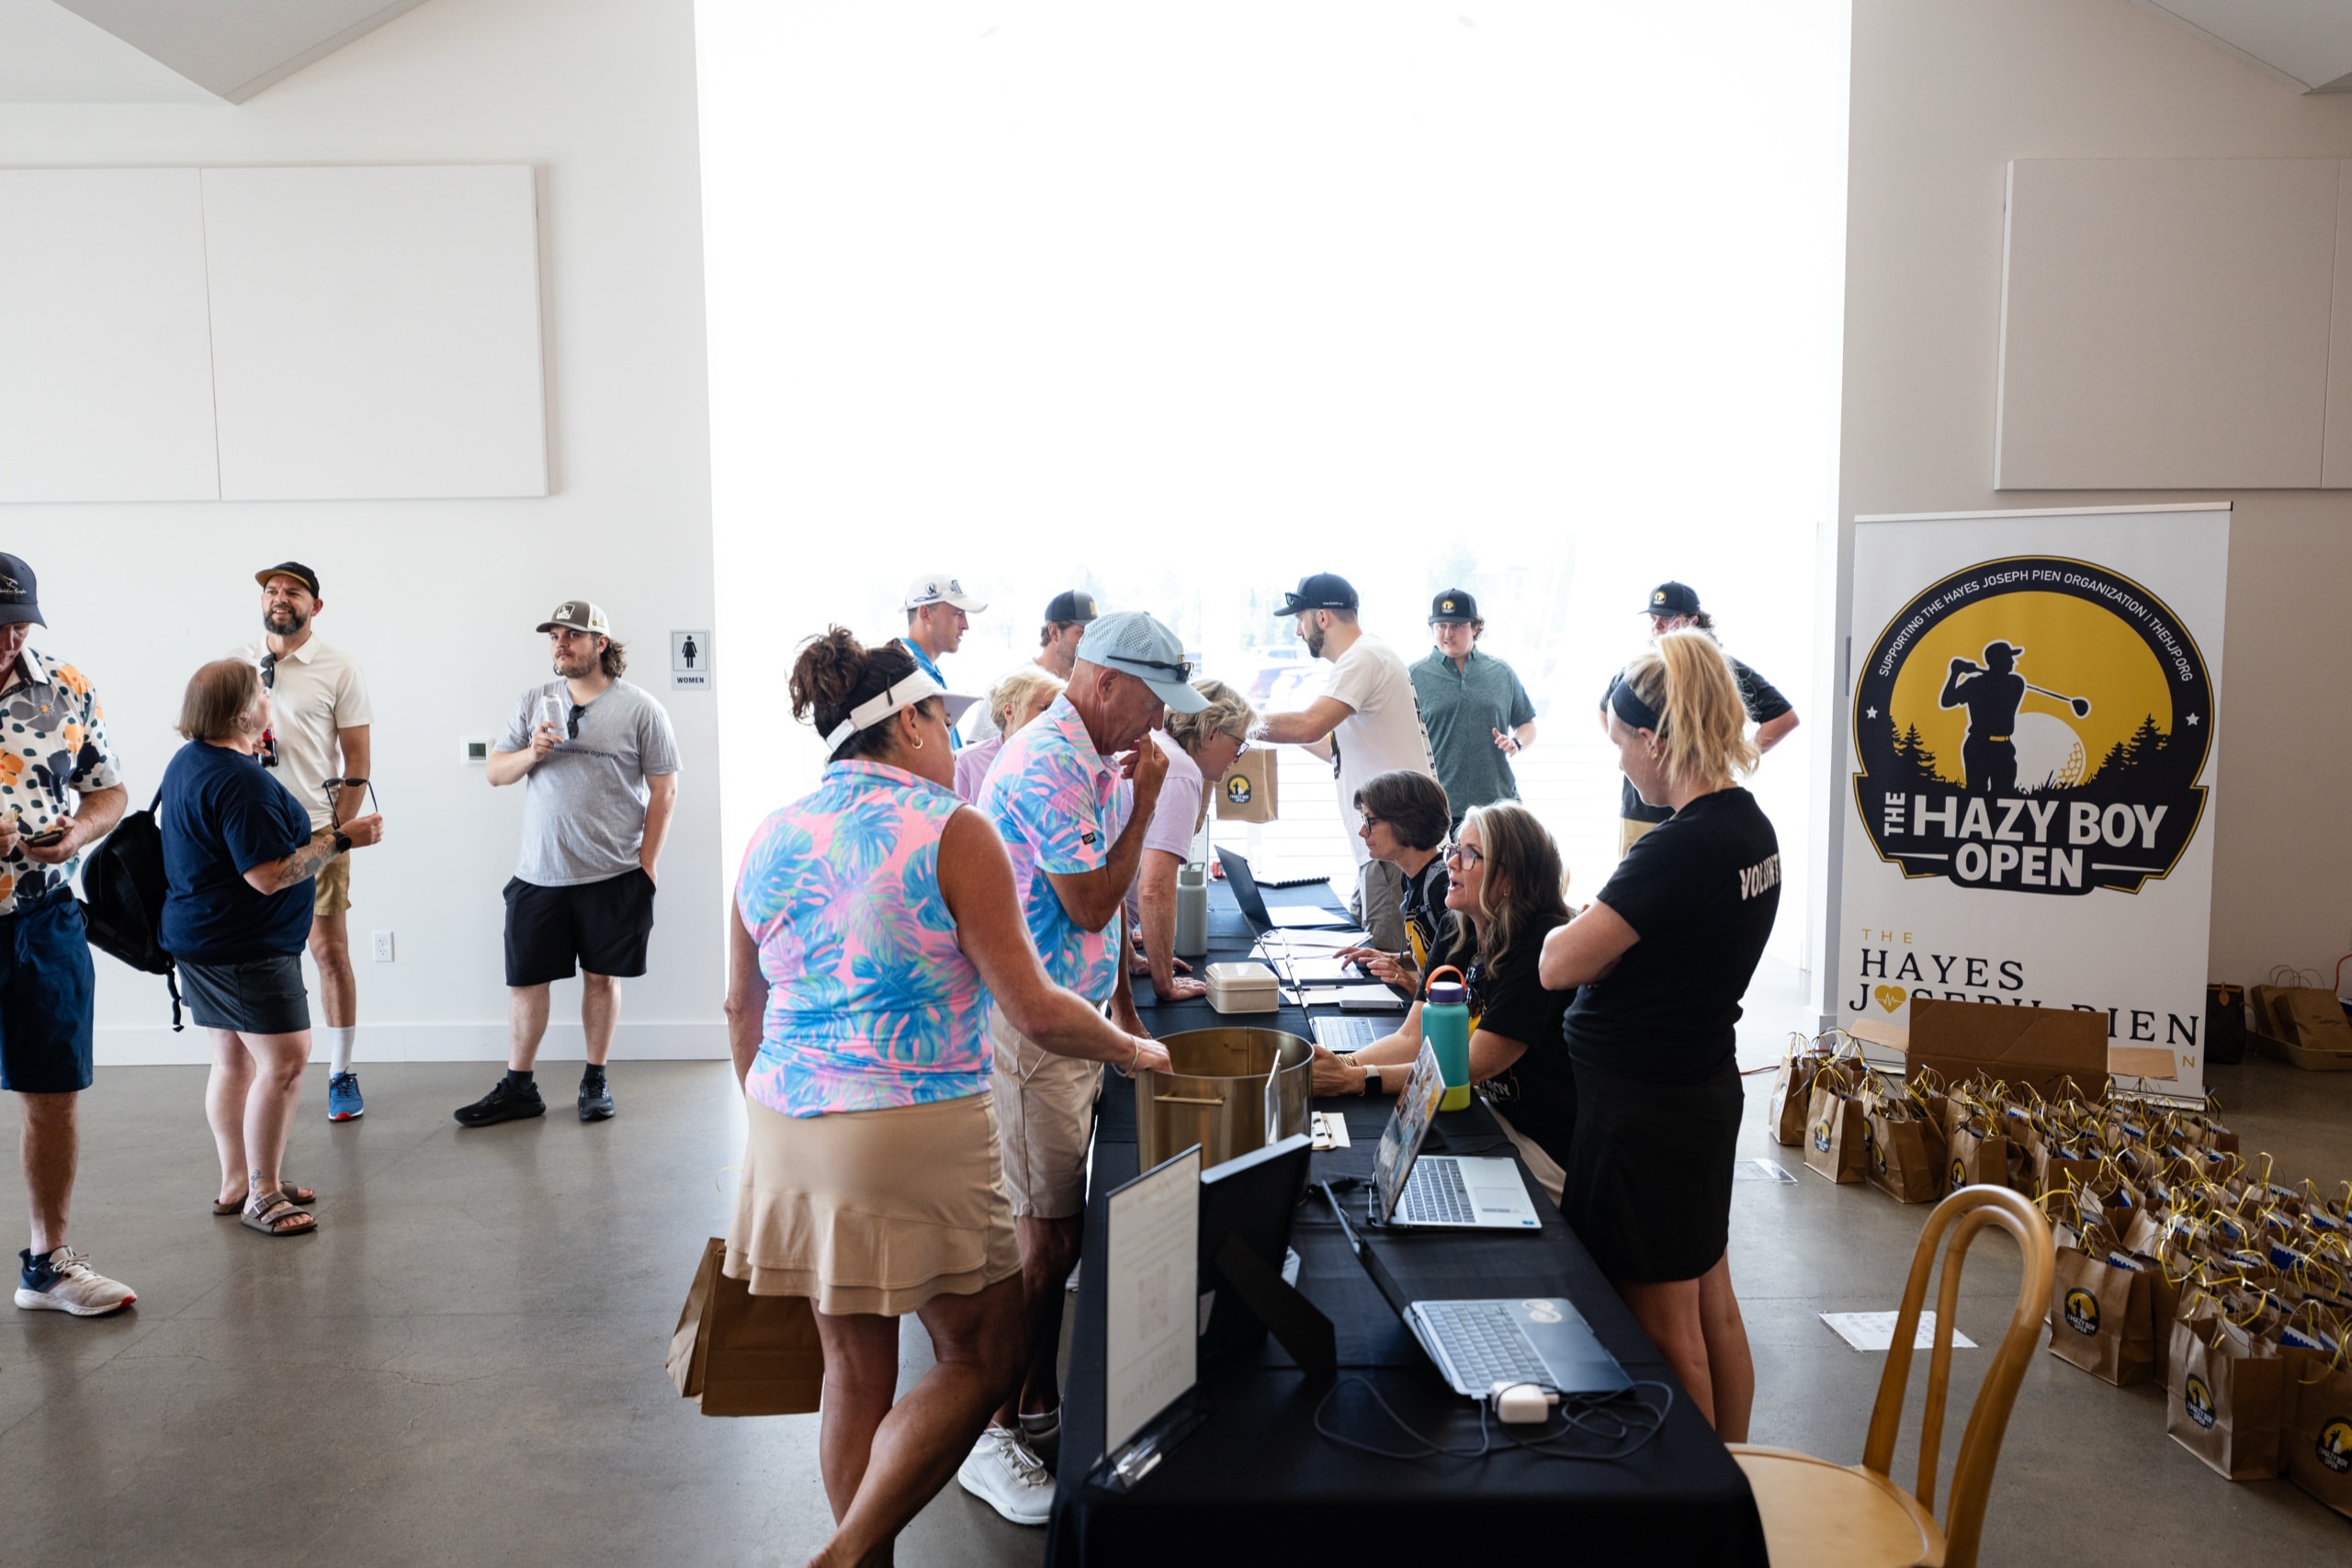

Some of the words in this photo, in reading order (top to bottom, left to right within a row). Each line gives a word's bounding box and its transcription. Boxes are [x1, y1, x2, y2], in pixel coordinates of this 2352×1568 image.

[1879, 615, 1924, 676] SUPPORTING
[1921, 599, 1945, 618] THE
[1943, 581, 1980, 604] HAYES
[1982, 570, 2029, 588] JOSEPH
[2032, 570, 2061, 581] PIEN
[2064, 573, 2148, 618] ORGANIZATION
[2148, 618, 2193, 682] THEHJP.ORG
[677, 676, 705, 684] WOMEN
[553, 746, 589, 755] nsurance
[590, 750, 618, 760] agency
[1884, 791, 1905, 837] THE
[1913, 795, 2060, 842] HAZY
[2068, 801, 2168, 850] BOY
[1738, 852, 1781, 901] VOLUNT
[1955, 842, 2084, 888] OPEN
[1861, 928, 1914, 944] THE
[1860, 948, 2025, 990] HAYES
[2071, 1003, 2199, 1046] IEN
